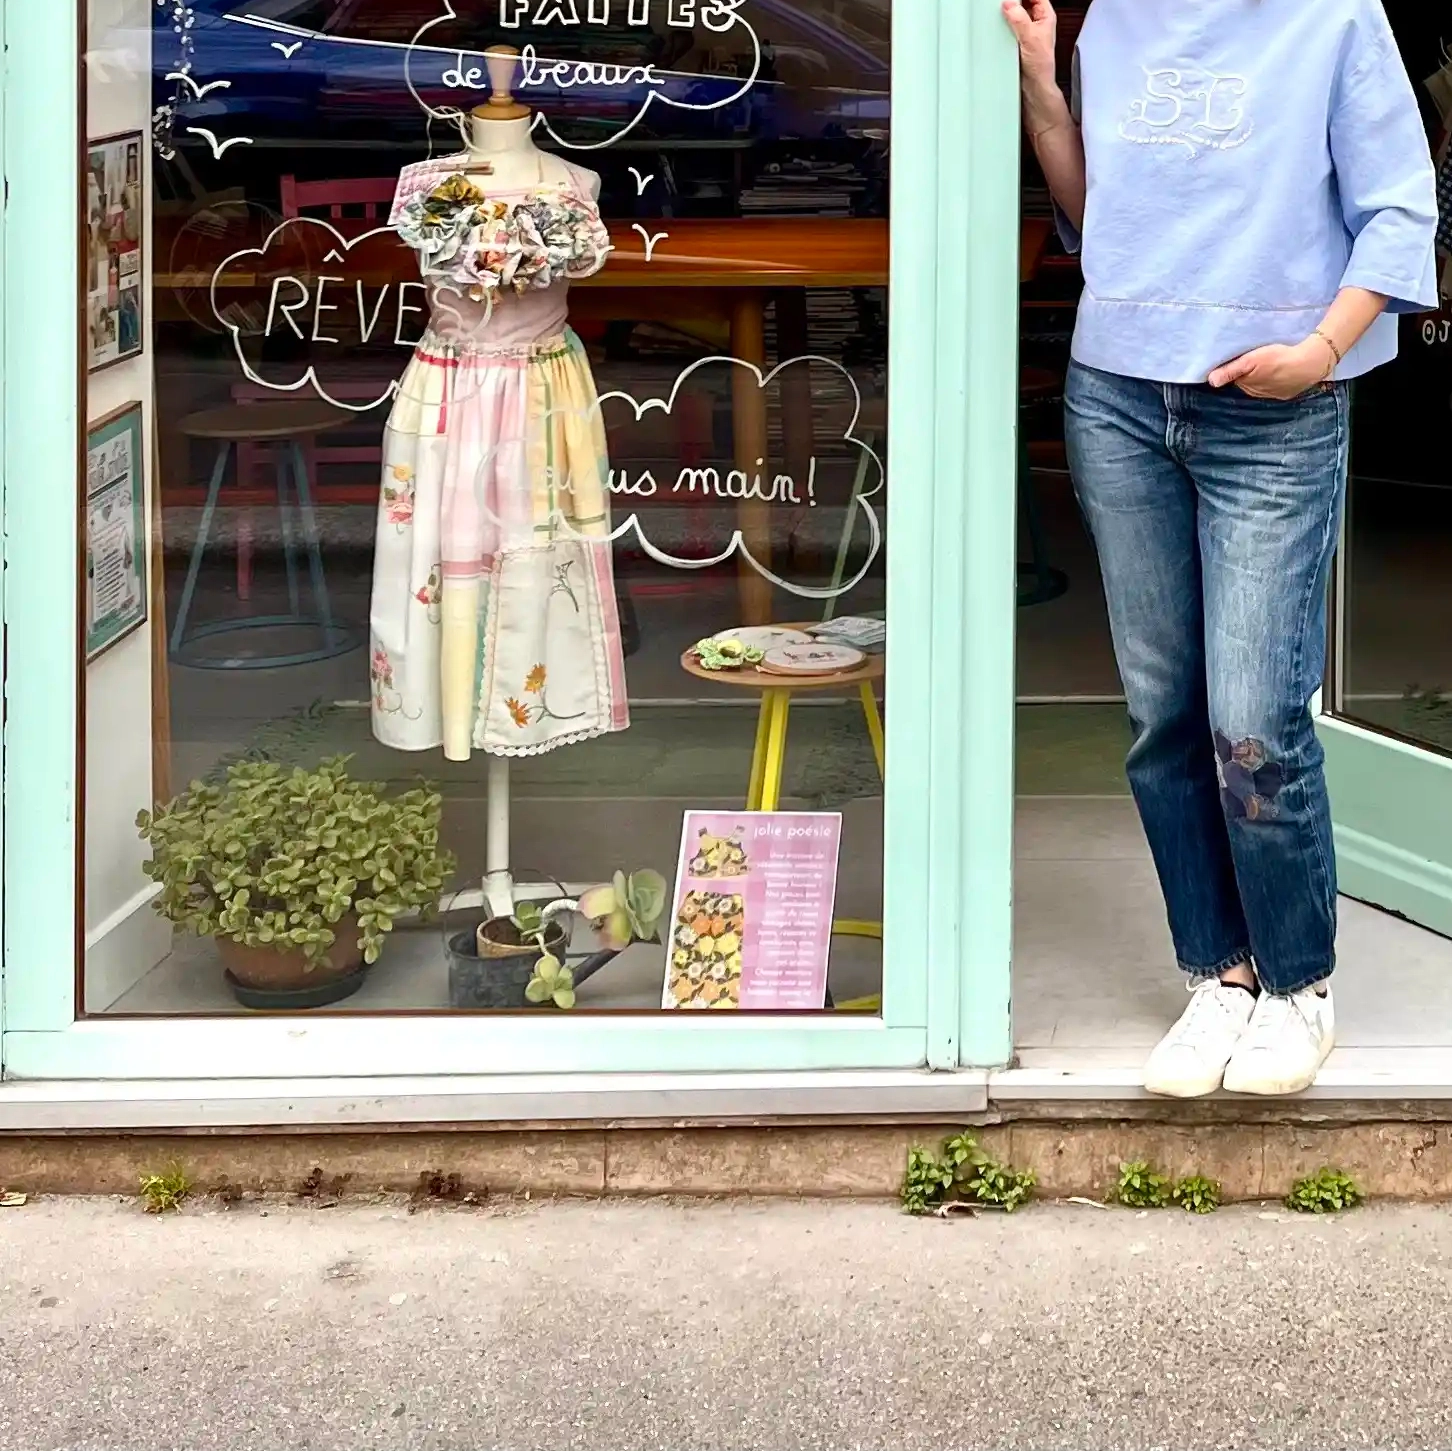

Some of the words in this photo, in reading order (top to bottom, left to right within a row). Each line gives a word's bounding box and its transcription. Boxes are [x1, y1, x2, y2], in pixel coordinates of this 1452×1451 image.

[442, 51, 486, 89] de
[520, 44, 665, 89] beaux
[264, 249, 472, 346] RÊVES
[673, 457, 816, 506] main!
[753, 821, 782, 839] jolie
[787, 822, 832, 840] poésie
